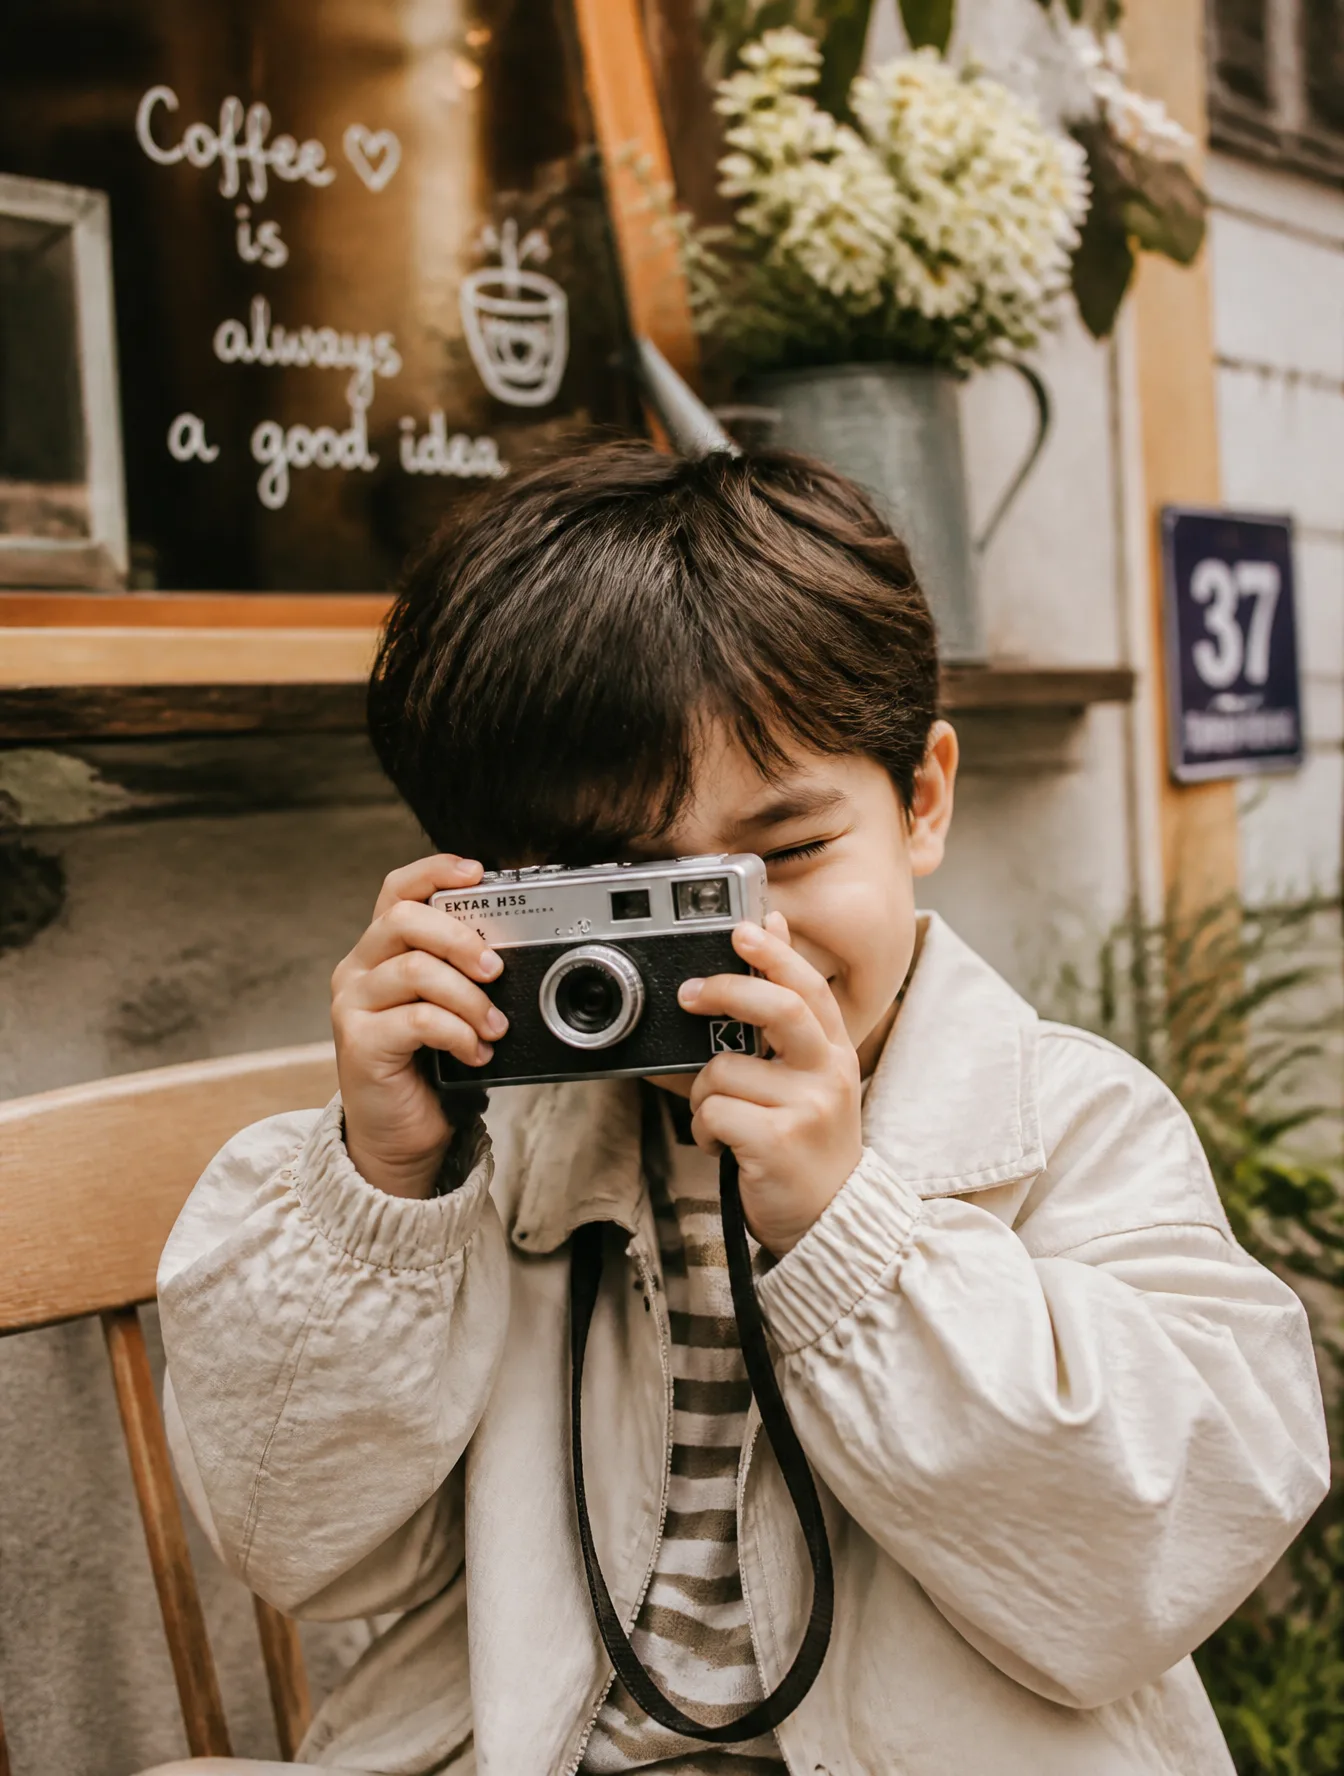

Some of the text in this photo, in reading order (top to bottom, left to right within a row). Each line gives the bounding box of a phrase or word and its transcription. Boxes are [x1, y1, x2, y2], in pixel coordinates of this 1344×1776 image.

[136, 85, 336, 201] Coffee
[236, 204, 288, 268] is
[214, 295, 402, 406] always
[168, 405, 511, 509] a good idea
[1189, 558, 1281, 689] 37
[445, 899, 490, 912] EKTAR
